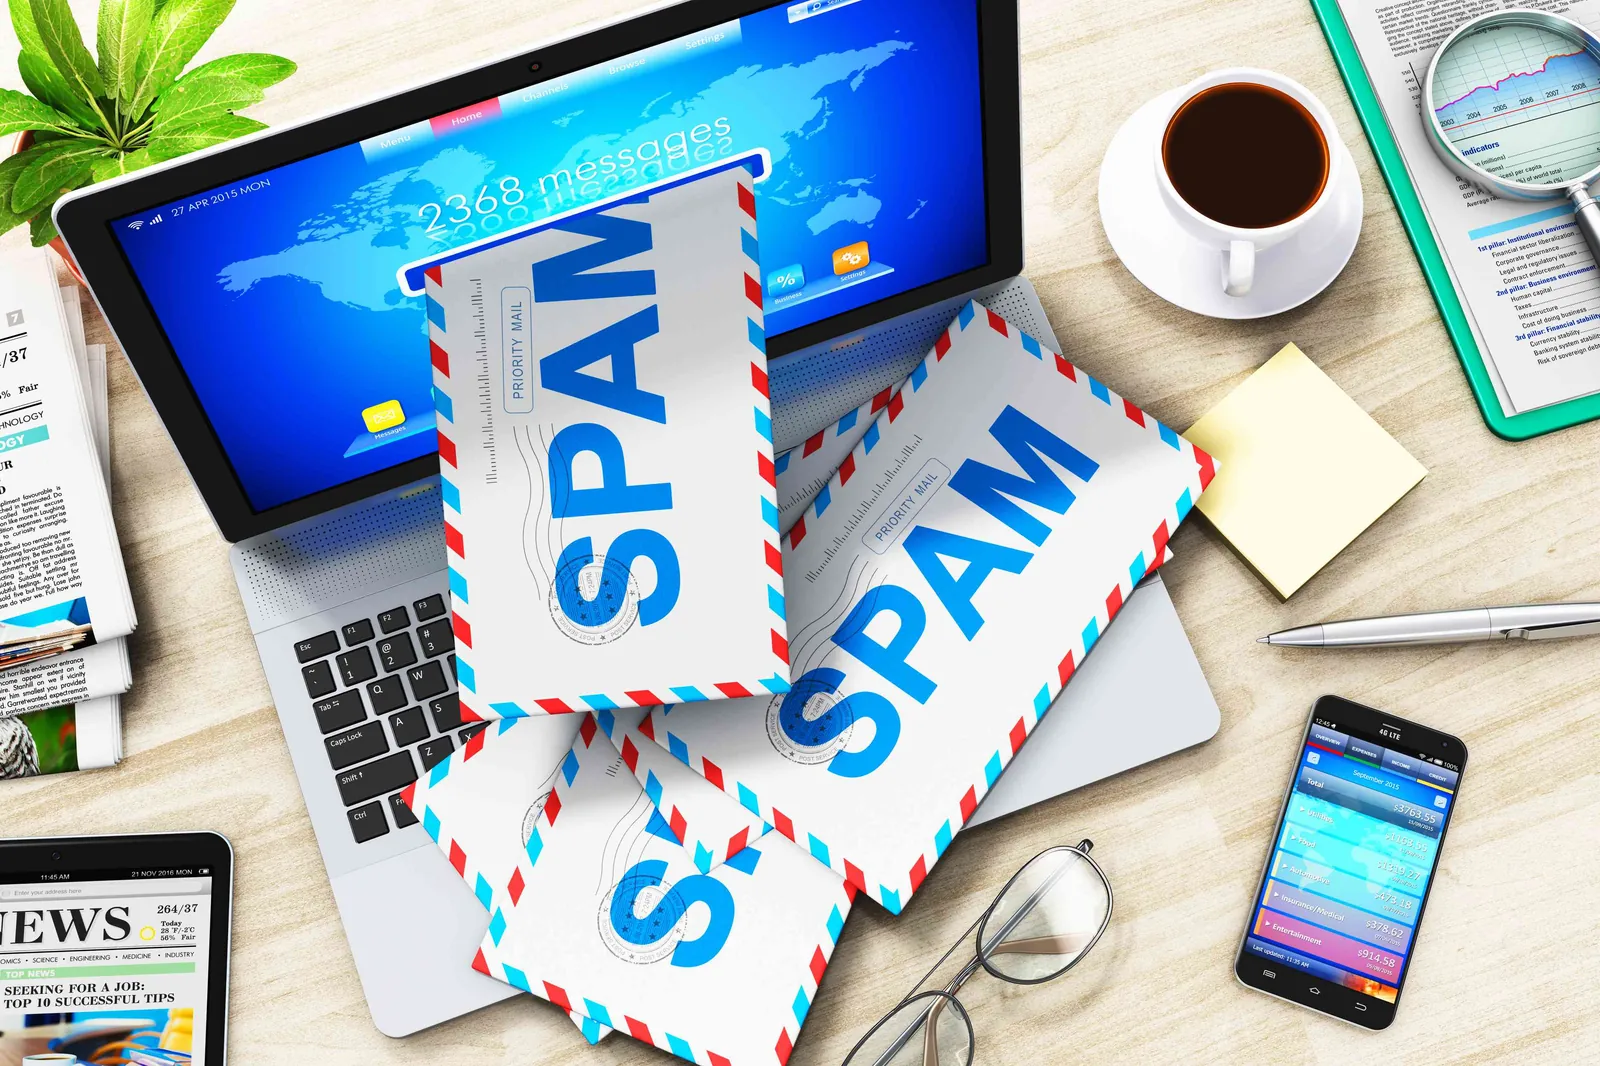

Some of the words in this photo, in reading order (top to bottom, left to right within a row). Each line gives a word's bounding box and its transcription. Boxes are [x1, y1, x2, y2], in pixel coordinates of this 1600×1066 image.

[380, 133, 411, 150] Menu
[451, 110, 483, 126] Home
[522, 82, 569, 104] Channels
[608, 56, 646, 76] Browse
[685, 31, 726, 51] Settings
[1441, 119, 1454, 127] 2003
[1466, 111, 1481, 120] 2004
[1493, 104, 1508, 113] 2005
[1519, 96, 1534, 105] 2006
[1545, 90, 1559, 98] 2007
[1572, 82, 1586, 91] 2008
[1461, 141, 1500, 157] indicators
[1481, 154, 1506, 166] (millions)
[418, 176, 524, 234] 2368
[538, 116, 732, 195] messages
[1525, 164, 1542, 173] capita
[1533, 171, 1549, 180] world
[1549, 168, 1562, 176] total
[172, 206, 184, 217] 27
[188, 199, 210, 212] APR
[210, 190, 238, 204] 2015
[239, 178, 271, 195] MON
[1467, 199, 1490, 208] Average
[1507, 229, 1544, 244] Institutional
[1492, 247, 1518, 258] Financial
[1519, 242, 1537, 250] sector
[1538, 231, 1575, 245] liberalization
[1495, 256, 1524, 267] Corporate
[1499, 267, 1515, 276] Legal
[1516, 263, 1528, 271] and
[1528, 256, 1558, 268] regulatory
[1559, 250, 1577, 259] issues
[1503, 274, 1529, 284] Contract
[1529, 263, 1566, 277] enforcement
[1528, 276, 1557, 288] Business
[1558, 264, 1597, 280] environment
[1511, 293, 1532, 302] Human
[1532, 286, 1552, 296] capital
[1514, 302, 1532, 311] Taxes
[1518, 305, 1558, 320] Infrastructure
[10, 312, 19, 323] 7
[511, 301, 523, 331] MAIL
[1522, 321, 1536, 329] Cost
[1544, 314, 1560, 324] doing
[1560, 307, 1587, 318] business
[1546, 320, 1575, 333] Financial
[1530, 336, 1557, 347] Currency
[1558, 329, 1580, 340] stability
[1533, 346, 1558, 356] Banking
[1559, 340, 1580, 349] system
[1558, 348, 1587, 360] sovereign
[512, 337, 524, 400] PRIORITY
[18, 383, 39, 394] Fair
[532, 195, 681, 626] SPAM
[374, 426, 406, 440] Messages
[875, 496, 916, 542] PRIORITY
[914, 472, 938, 496] MAIL
[33, 534, 58, 544] removing
[50, 549, 75, 559] travelling
[780, 404, 1100, 778] SPAM
[418, 601, 428, 609] F3
[383, 614, 392, 622] F2
[347, 626, 356, 634] F1
[300, 643, 312, 652] Esc
[382, 643, 392, 654] @
[428, 642, 435, 651] 3
[7, 668, 30, 678] horrible
[31, 663, 58, 673] endeavor
[59, 657, 84, 666] entrance
[387, 656, 394, 665] 2
[22, 673, 42, 682] appear
[347, 670, 354, 680] 1
[412, 670, 423, 680] W
[23, 687, 45, 696] smallest
[60, 678, 86, 688] provided
[373, 685, 383, 694] Q
[319, 703, 332, 712] Tab
[435, 704, 442, 713] S
[396, 717, 404, 726] A
[330, 737, 346, 747] Caps
[347, 731, 363, 742] Lock
[1315, 718, 1331, 727] 12:45
[1379, 728, 1388, 737] 4G
[1388, 731, 1401, 741] LTE
[1443, 761, 1459, 771] 100%
[425, 747, 433, 757] Z
[1315, 734, 1340, 746] OVERVIEW
[1351, 746, 1377, 759] EXPENSES
[1391, 759, 1410, 770] INCOME
[1429, 772, 1447, 782] CREDIT
[341, 774, 358, 785] Shift
[1352, 769, 1384, 786] September
[1384, 780, 1400, 790] 2015
[395, 798, 405, 806] Fn
[1307, 777, 1324, 789] Total
[1394, 804, 1436, 824] $3763.55
[354, 811, 367, 821] Ctrl
[1290, 866, 1330, 885] Automotive
[1374, 892, 1412, 909] $473.18
[157, 904, 198, 915] 264/37
[1282, 894, 1344, 922] Insurance/Medical
[1365, 920, 1404, 939] $378.62
[1253, 944, 1263, 952] Last
[1264, 948, 1285, 960] updated:
[1272, 923, 1322, 945] Entertainment
[1357, 949, 1396, 968] $914.58
[70, 954, 110, 962] ENGINEERING
[28, 969, 56, 977] NEWS
[4, 984, 64, 996] SEEKING
[69, 983, 96, 993] FOR
[101, 982, 109, 992] A
[114, 982, 145, 992] JOB:
[4, 998, 32, 1009] TOP
[37, 998, 51, 1007] 10
[55, 995, 140, 1007] SUCCESSFUL
[144, 993, 175, 1003] TIPS
